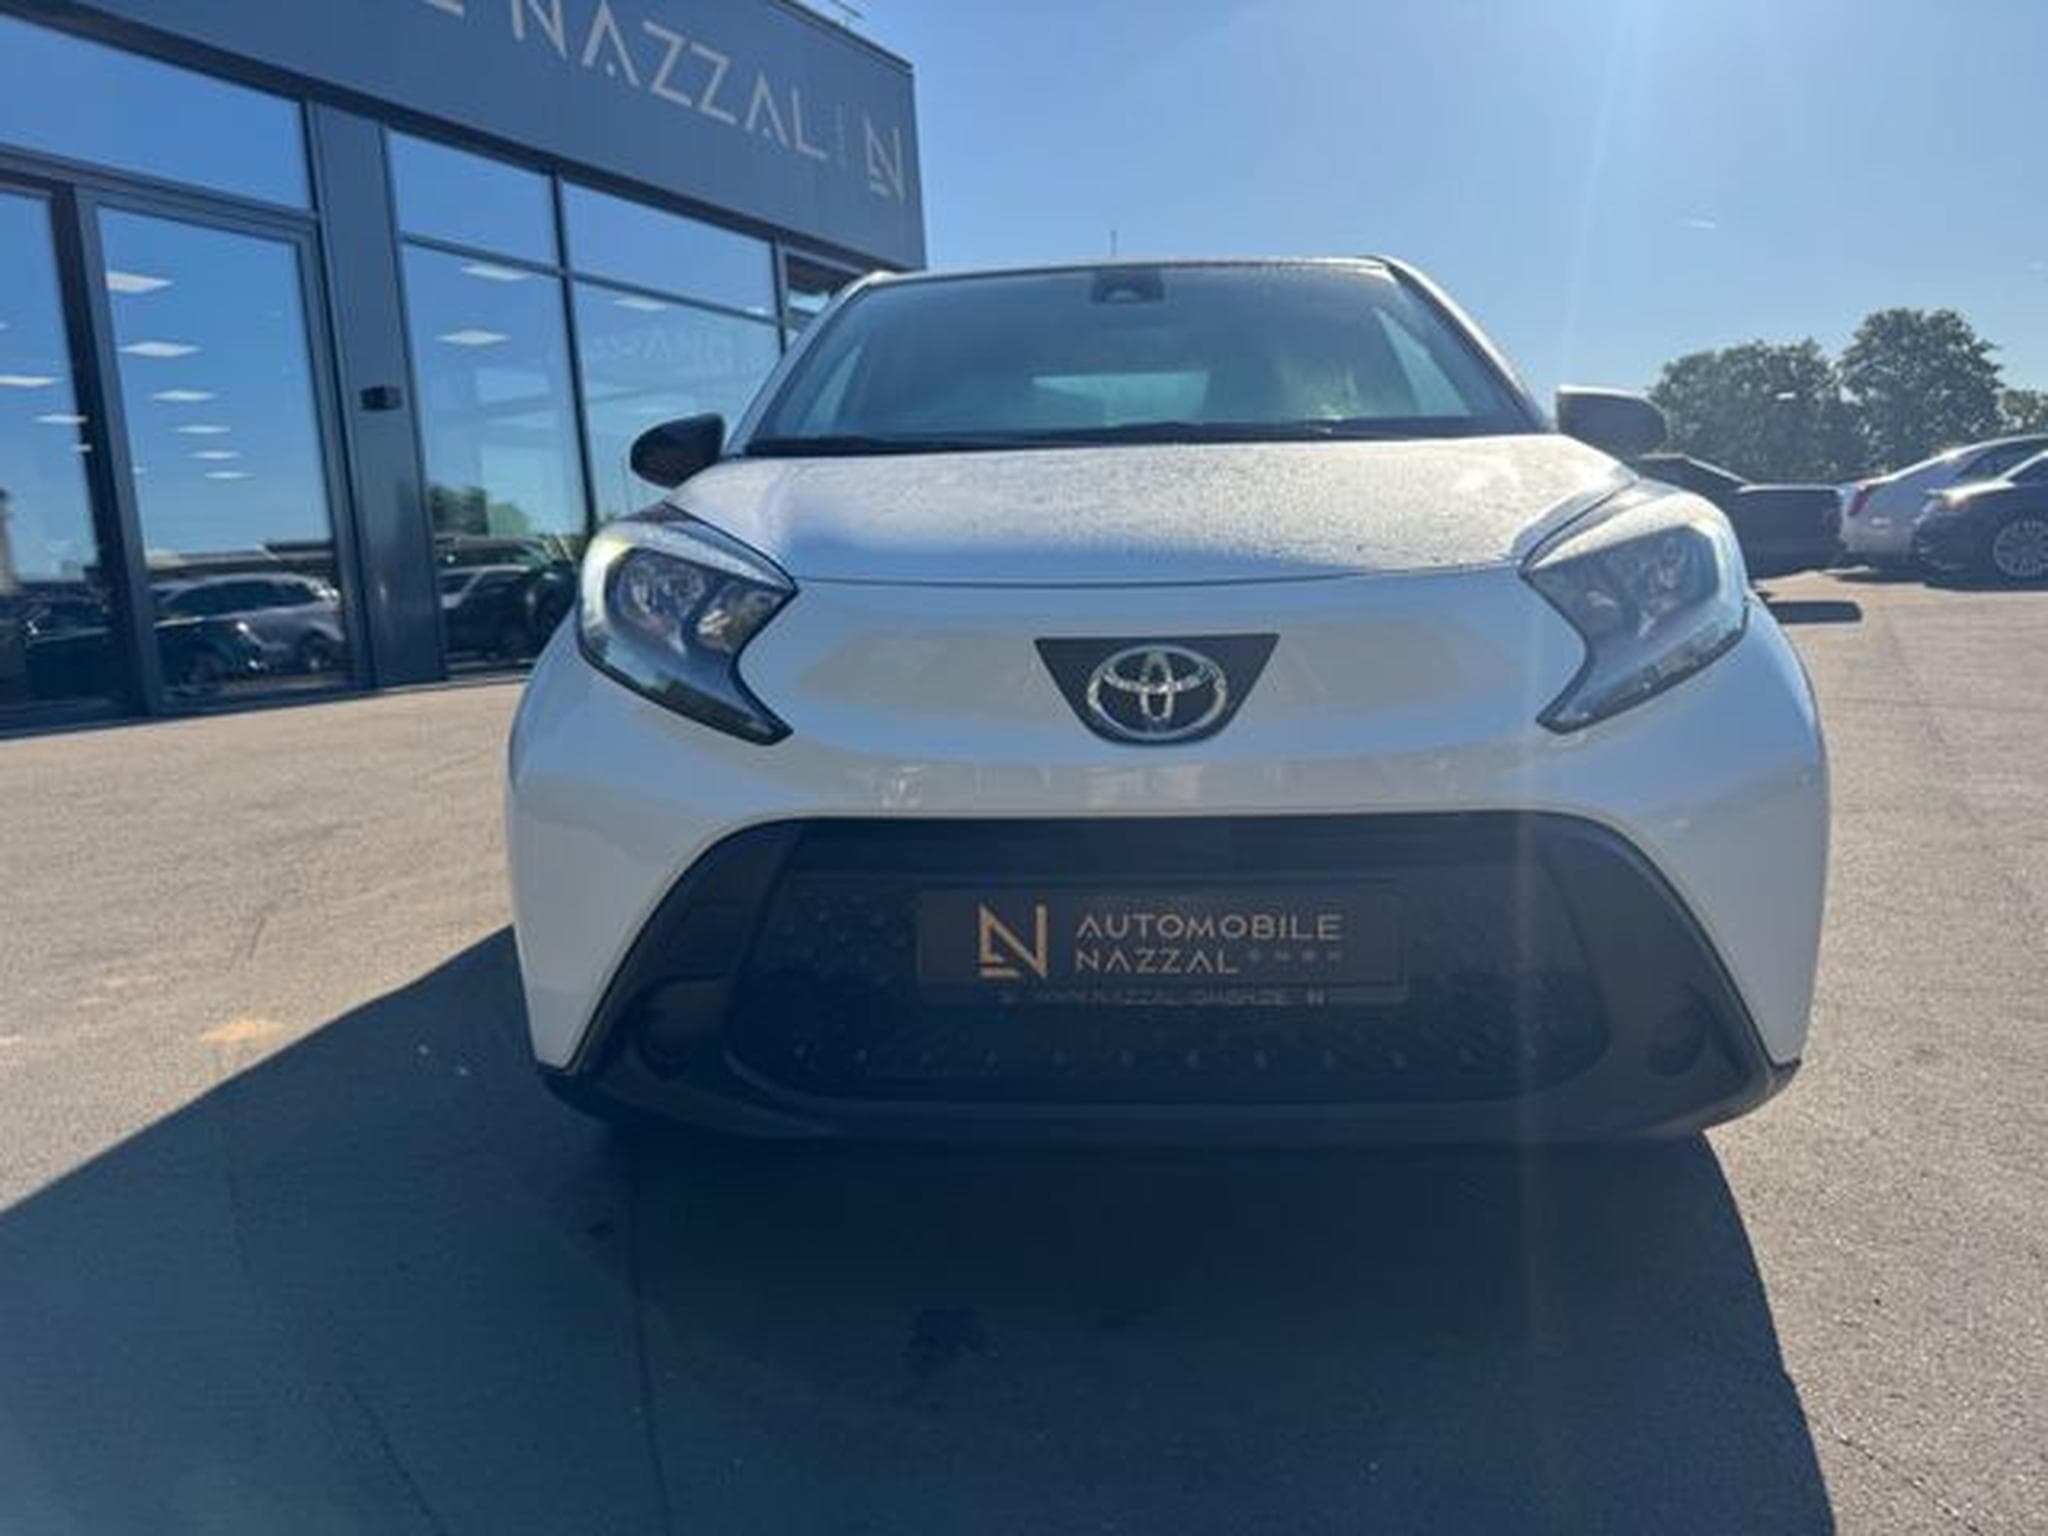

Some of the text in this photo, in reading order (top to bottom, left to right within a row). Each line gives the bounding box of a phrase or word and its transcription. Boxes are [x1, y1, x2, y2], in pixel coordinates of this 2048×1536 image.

[510, 0, 828, 160] NAZZAL
[1075, 912, 1343, 941] AUTOMOBILE
[1075, 948, 1239, 975] NAZZAL
